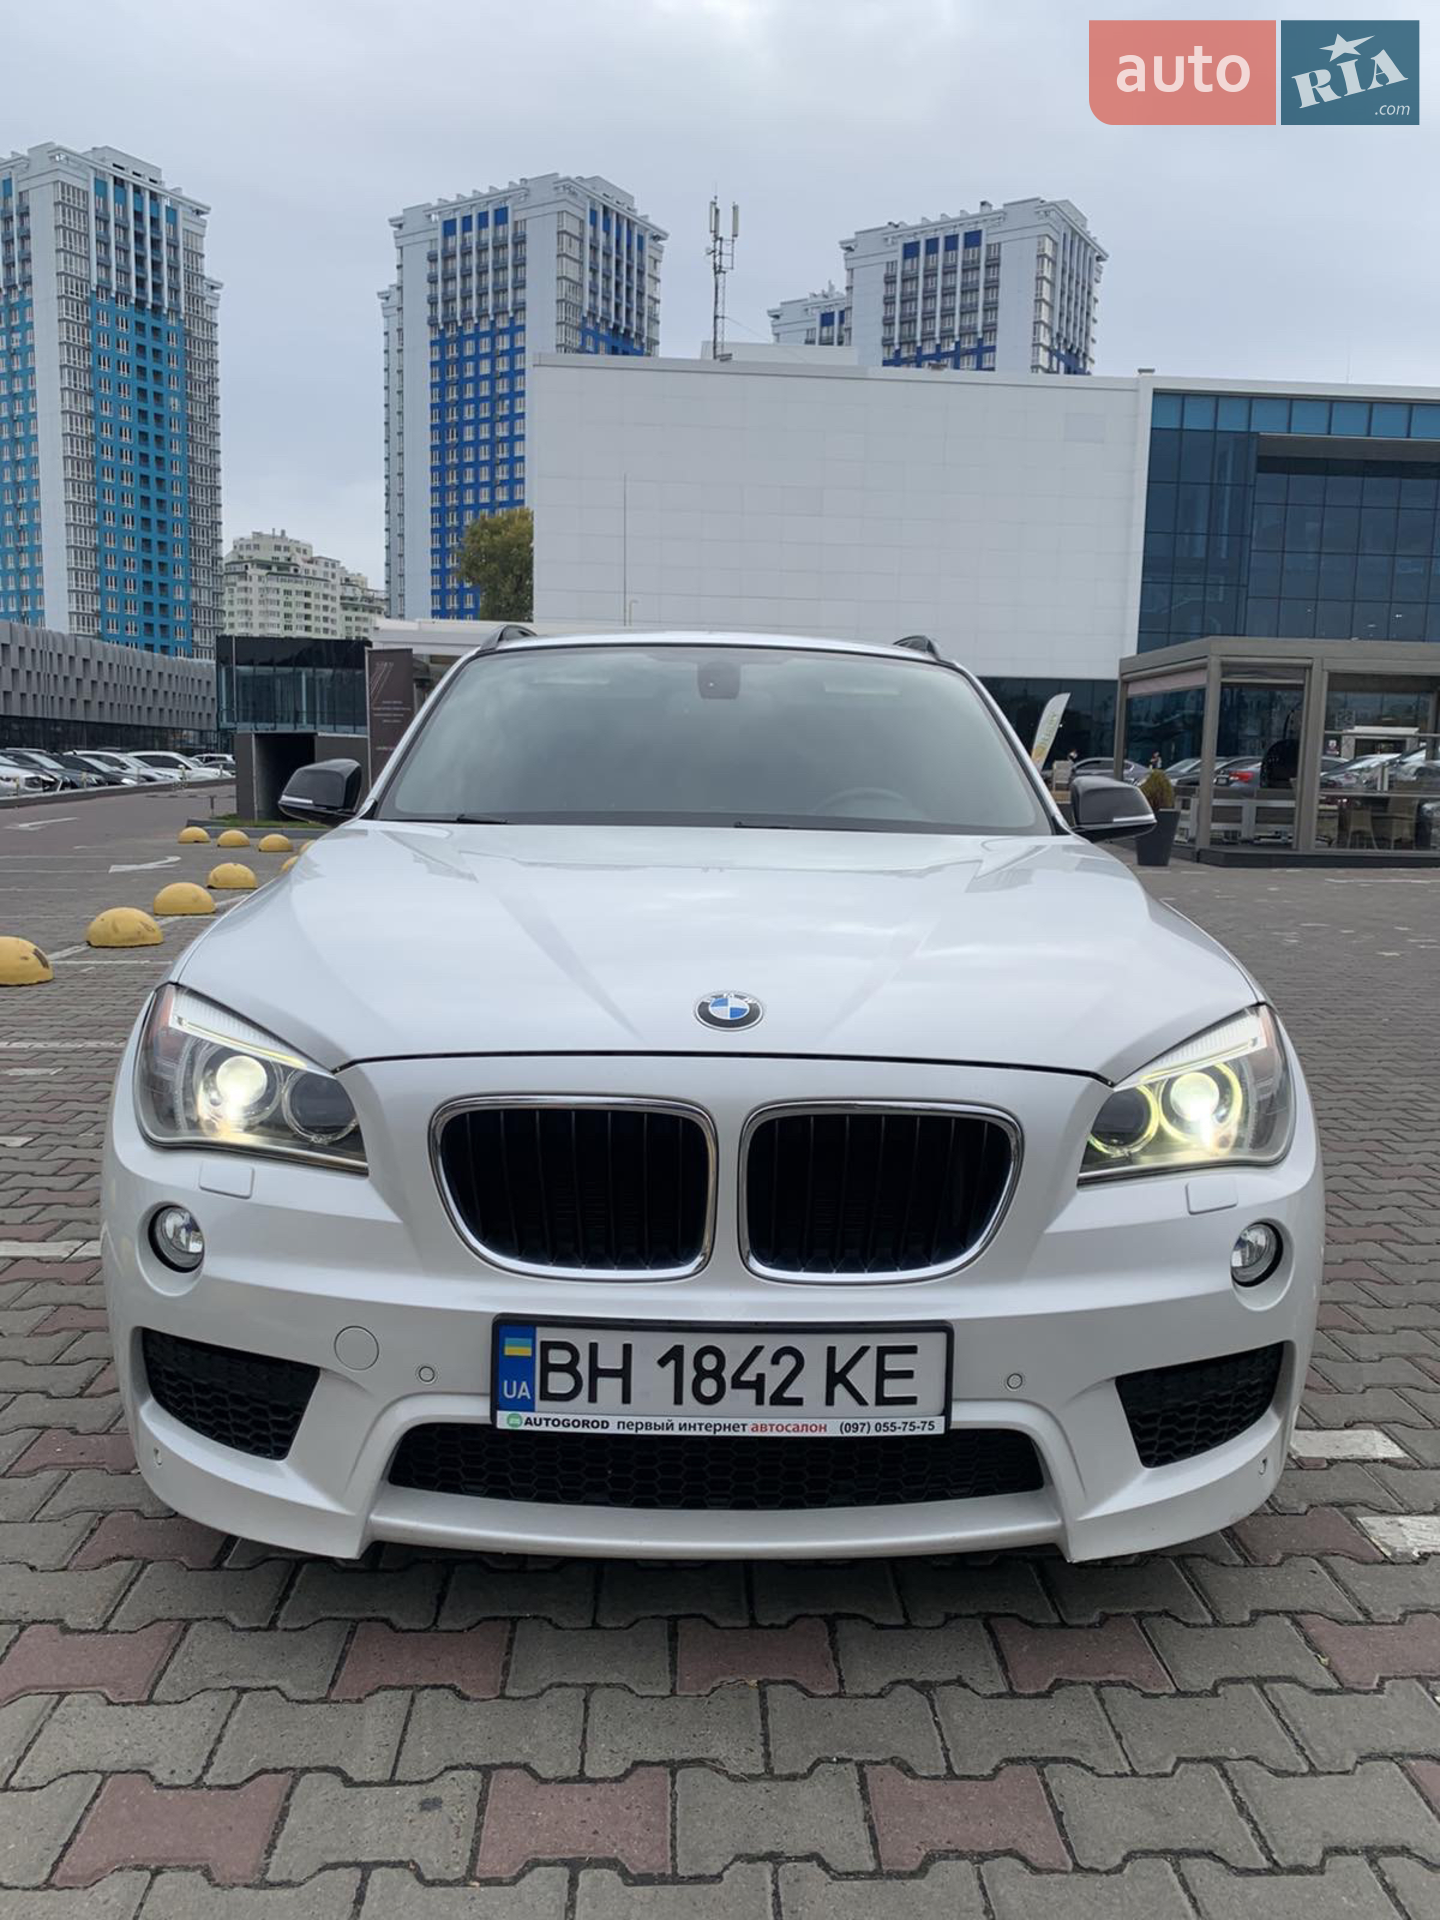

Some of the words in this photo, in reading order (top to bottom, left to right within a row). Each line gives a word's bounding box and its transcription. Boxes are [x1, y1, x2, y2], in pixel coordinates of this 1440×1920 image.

[540, 1340, 632, 1405] BH
[657, 1344, 805, 1406] 1842
[825, 1344, 918, 1407] KE
[503, 1381, 531, 1400] UA
[525, 1416, 610, 1430] AUTOGOROD
[617, 1419, 675, 1433] первый
[678, 1421, 748, 1434] интернет
[750, 1423, 827, 1434] автосалон
[839, 1421, 871, 1435] (097)
[874, 1421, 936, 1433] 055-75-75
